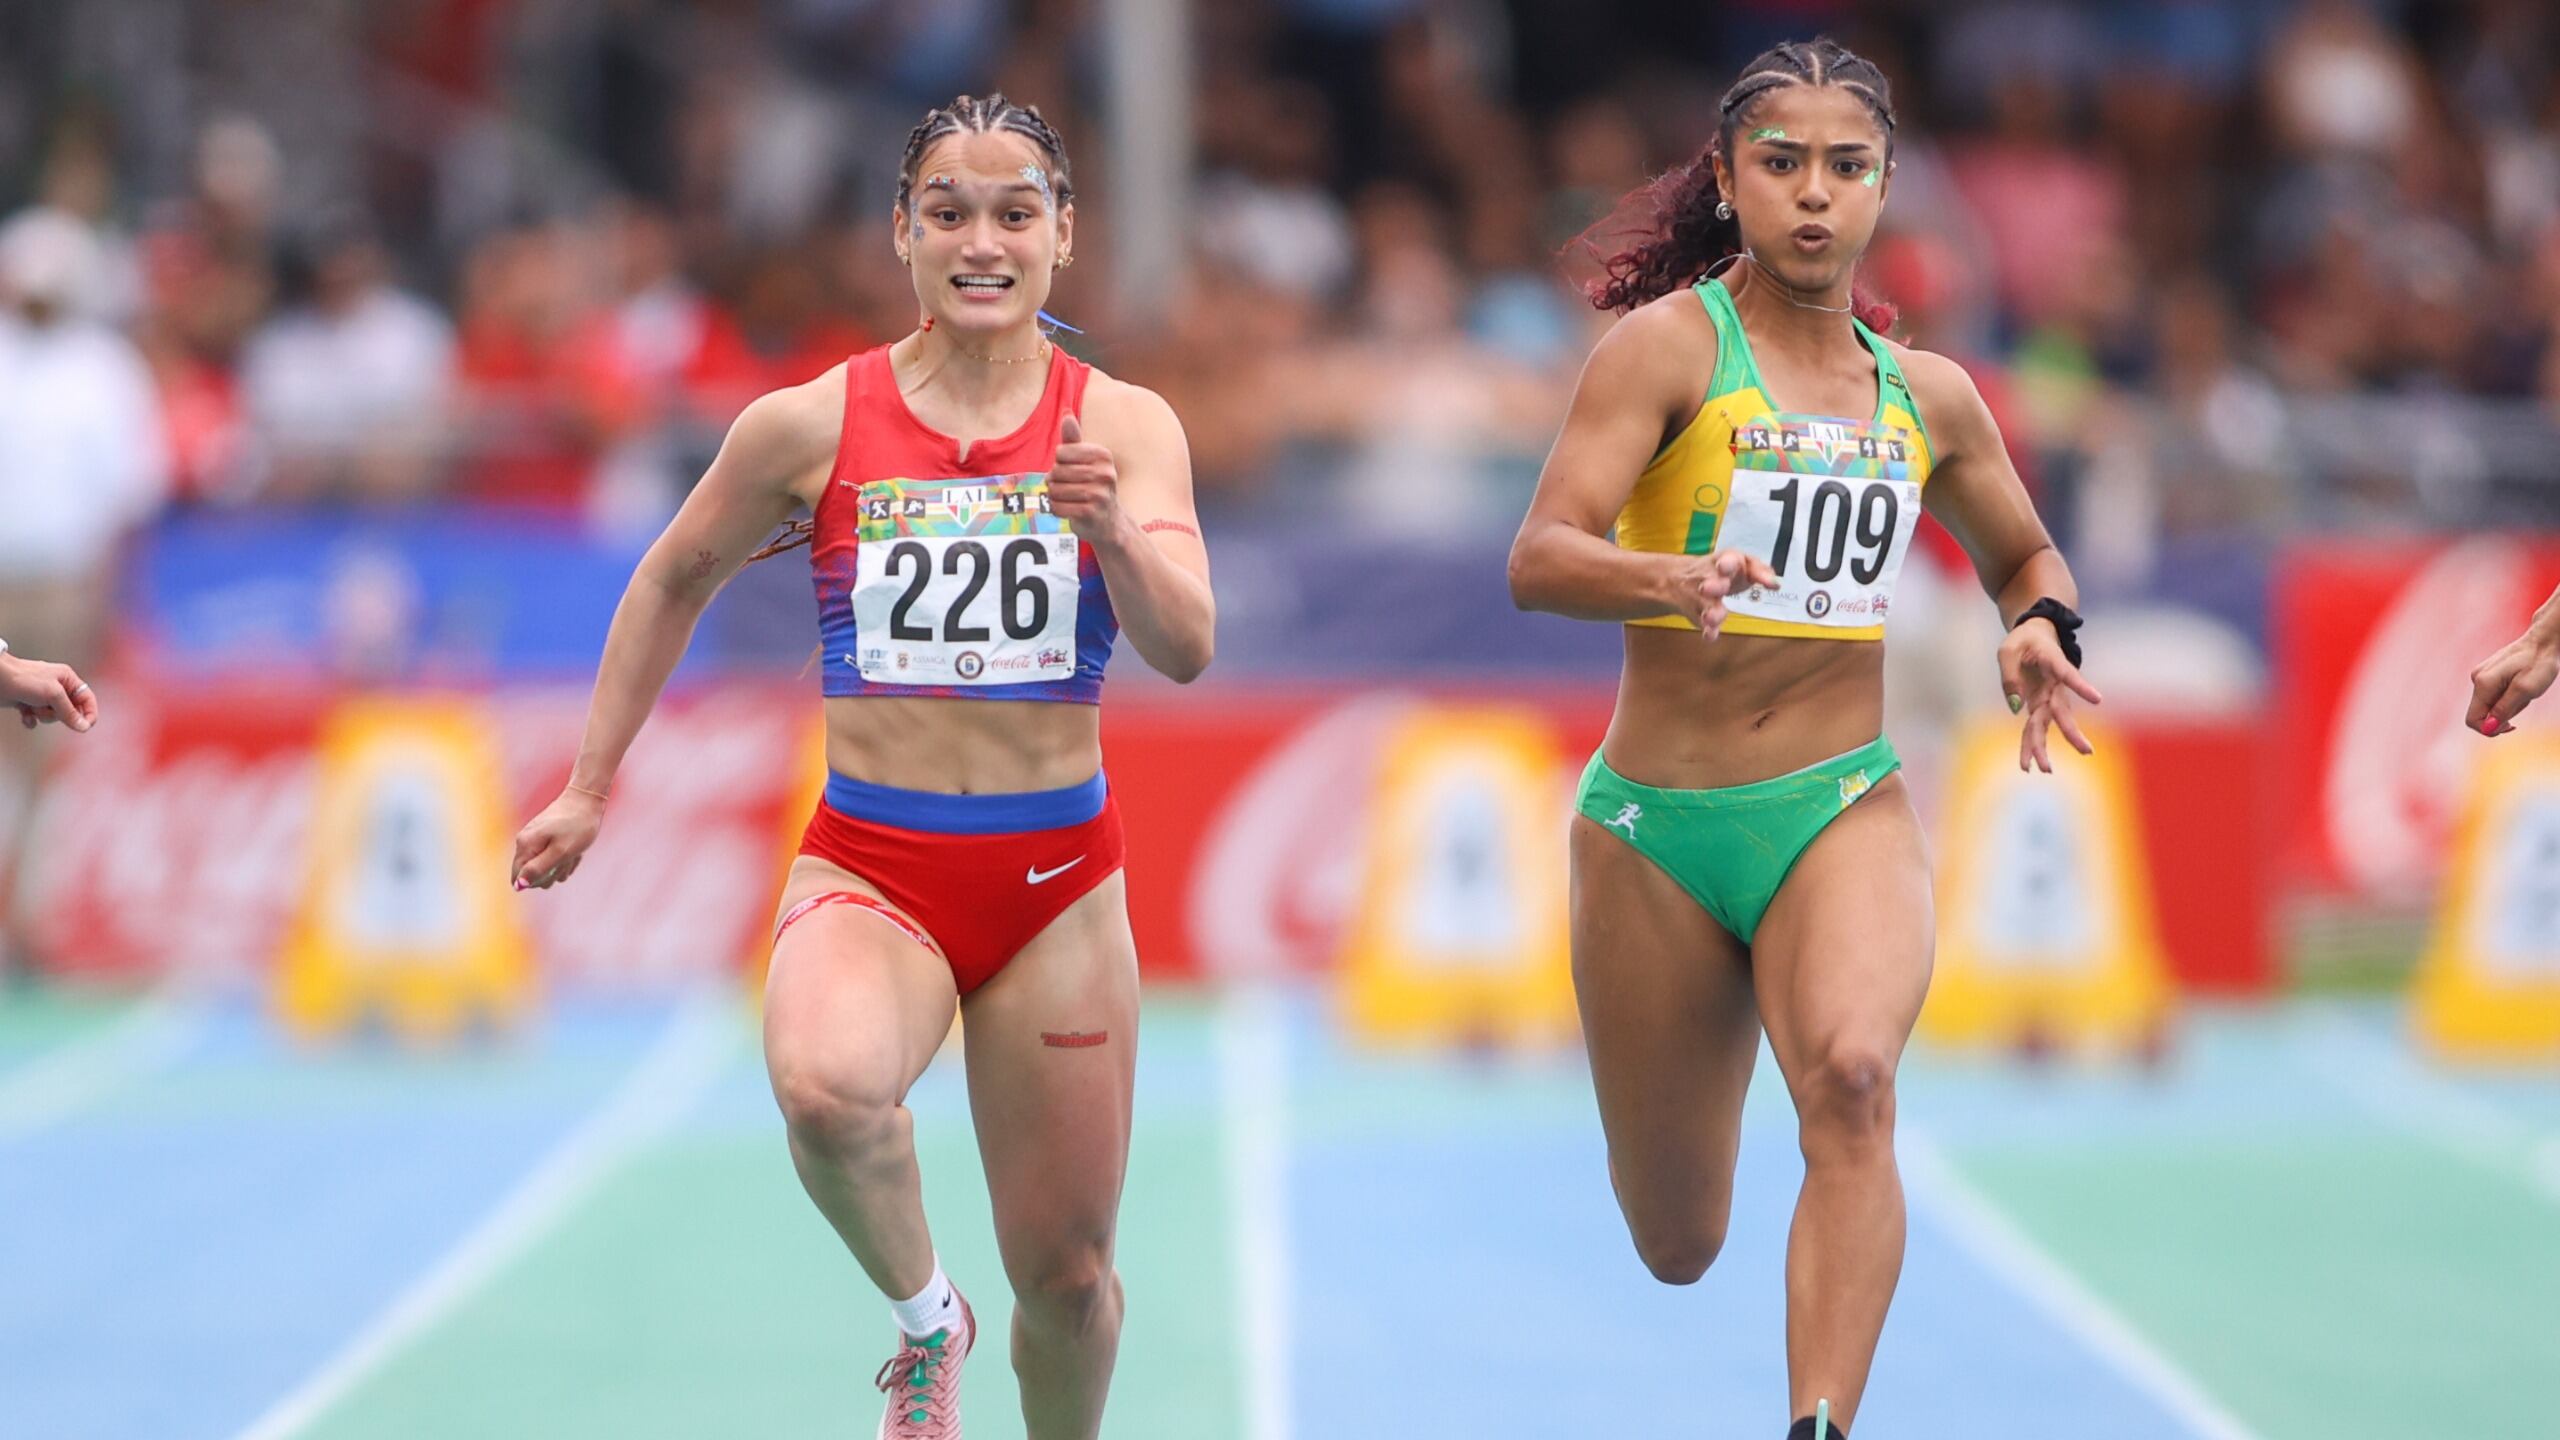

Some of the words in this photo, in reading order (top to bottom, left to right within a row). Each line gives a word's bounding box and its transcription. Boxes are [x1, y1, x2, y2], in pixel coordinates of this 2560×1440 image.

[1811, 424, 1842, 441] LAI
[946, 488, 983, 504] LAI
[1769, 478, 1898, 585] 109
[885, 538, 1049, 642] 226
